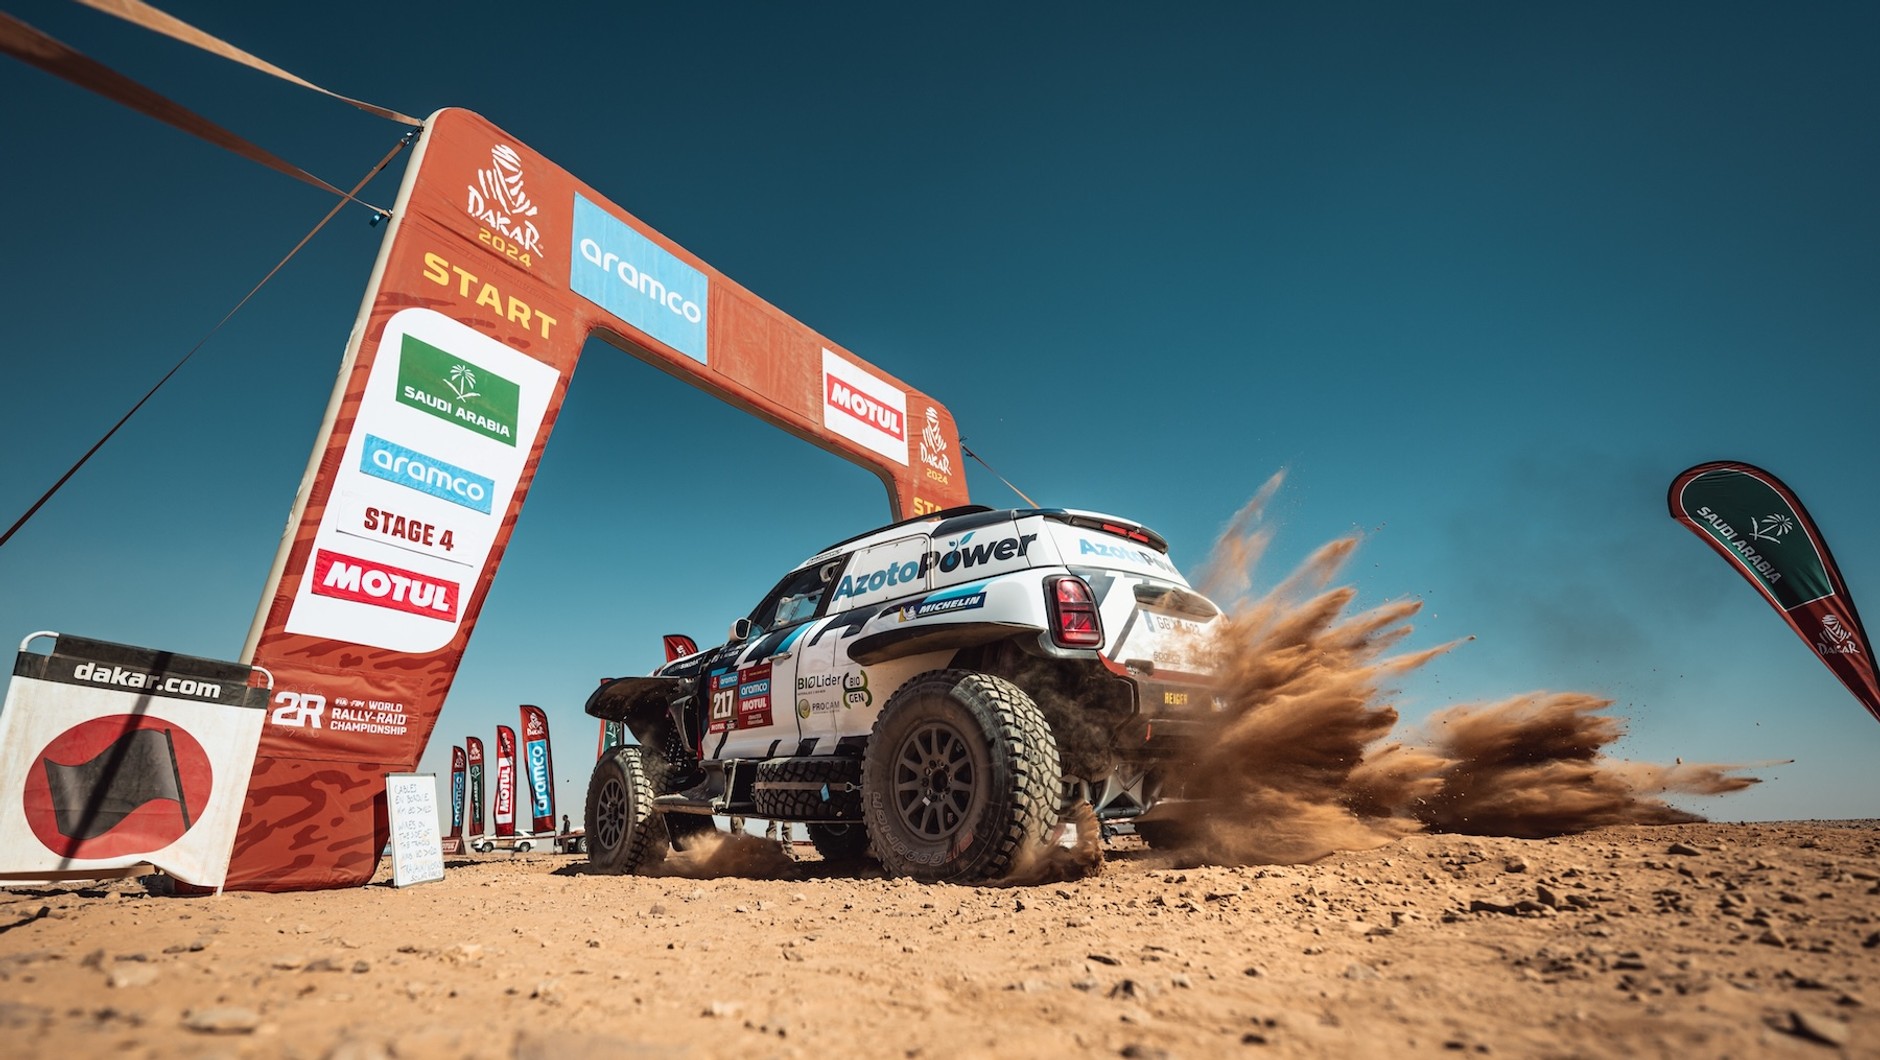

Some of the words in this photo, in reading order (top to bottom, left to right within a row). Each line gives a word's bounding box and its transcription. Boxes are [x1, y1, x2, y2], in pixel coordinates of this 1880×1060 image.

[467, 185, 544, 258] DAKAR
[478, 227, 532, 268] 2024
[423, 251, 557, 340] START
[580, 237, 702, 325] aramco
[404, 385, 452, 414] SAUDI
[455, 406, 511, 438] ARABIA
[831, 382, 900, 435] MOTUL
[372, 449, 485, 502] aramco
[919, 442, 952, 476] DAKAR
[926, 468, 949, 485] 2024
[913, 497, 944, 516] STA
[364, 506, 435, 547] STAGE
[440, 530, 454, 551] 4
[1697, 506, 1738, 540] SAUDI
[1732, 537, 1782, 585] ARABIA
[832, 533, 1038, 602] AzotoPower
[322, 560, 450, 612] MOTUL
[918, 595, 982, 615] MICHELIN
[1817, 640, 1860, 656] DAKAR
[74, 662, 221, 699] dakar.com
[740, 682, 768, 695] aramco
[849, 676, 860, 687] BIO
[849, 693, 865, 703] GEN
[331, 708, 407, 726] RALLY-RAID
[368, 700, 403, 712] WORLD
[713, 689, 734, 719] 217
[741, 697, 767, 711] MOTUL
[812, 701, 840, 711] PROCAM
[330, 720, 408, 736] CHAMPIONSHIP
[499, 766, 511, 812] MOTUL
[534, 745, 548, 811] aramco
